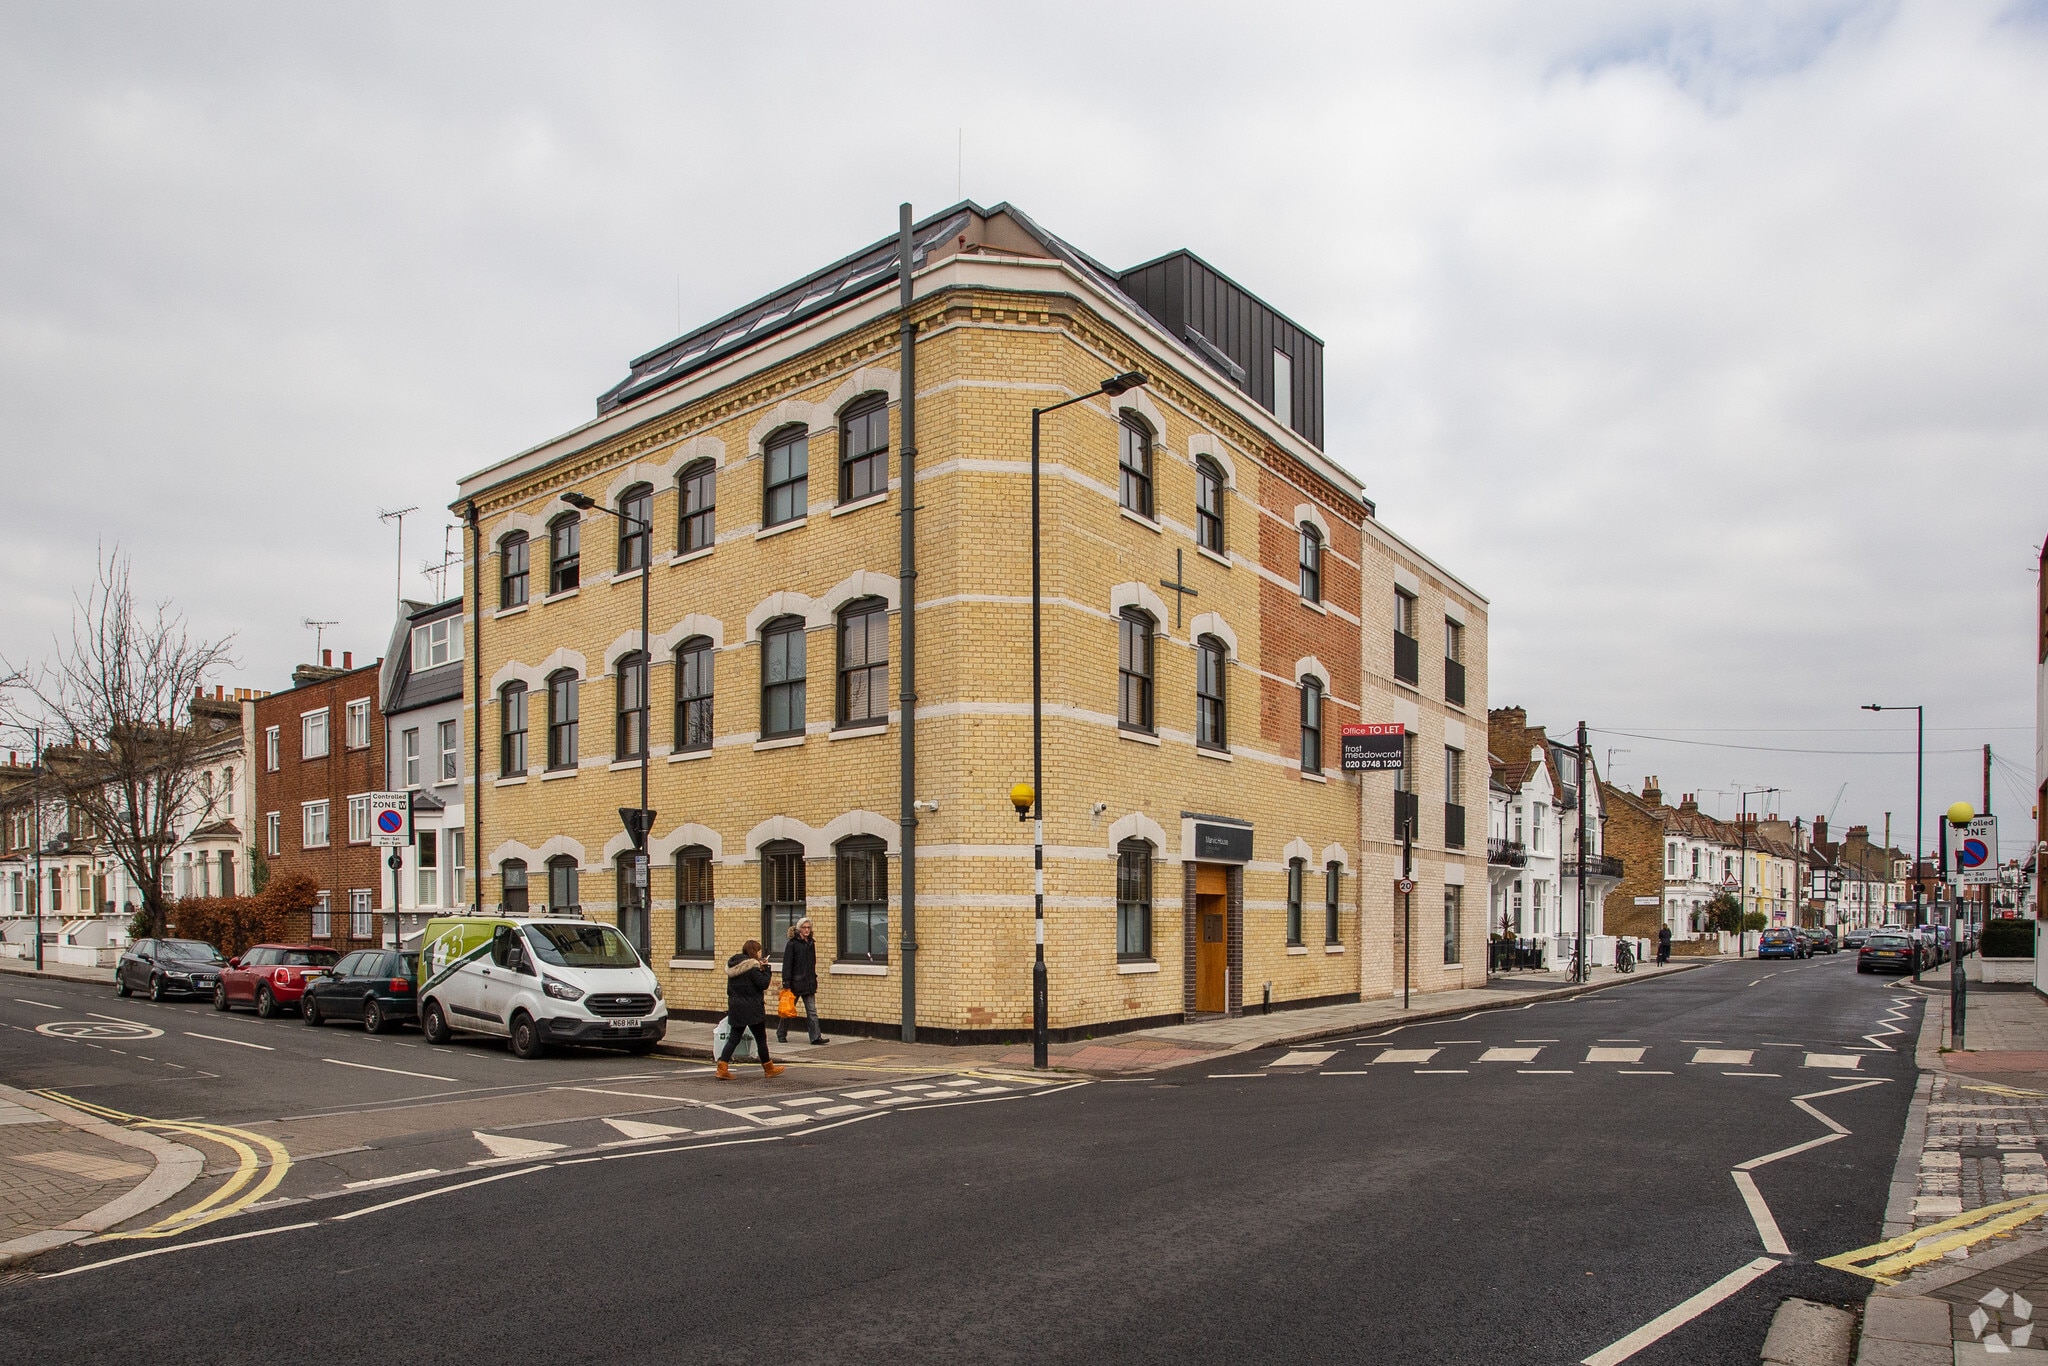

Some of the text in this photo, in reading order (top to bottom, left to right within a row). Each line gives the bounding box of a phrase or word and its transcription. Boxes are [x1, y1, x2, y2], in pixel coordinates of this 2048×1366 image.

[1368, 726, 1381, 734] TO
[1384, 726, 1400, 734] LET
[1345, 750, 1402, 758] meadowcroft
[54, 1026, 144, 1036] 20
